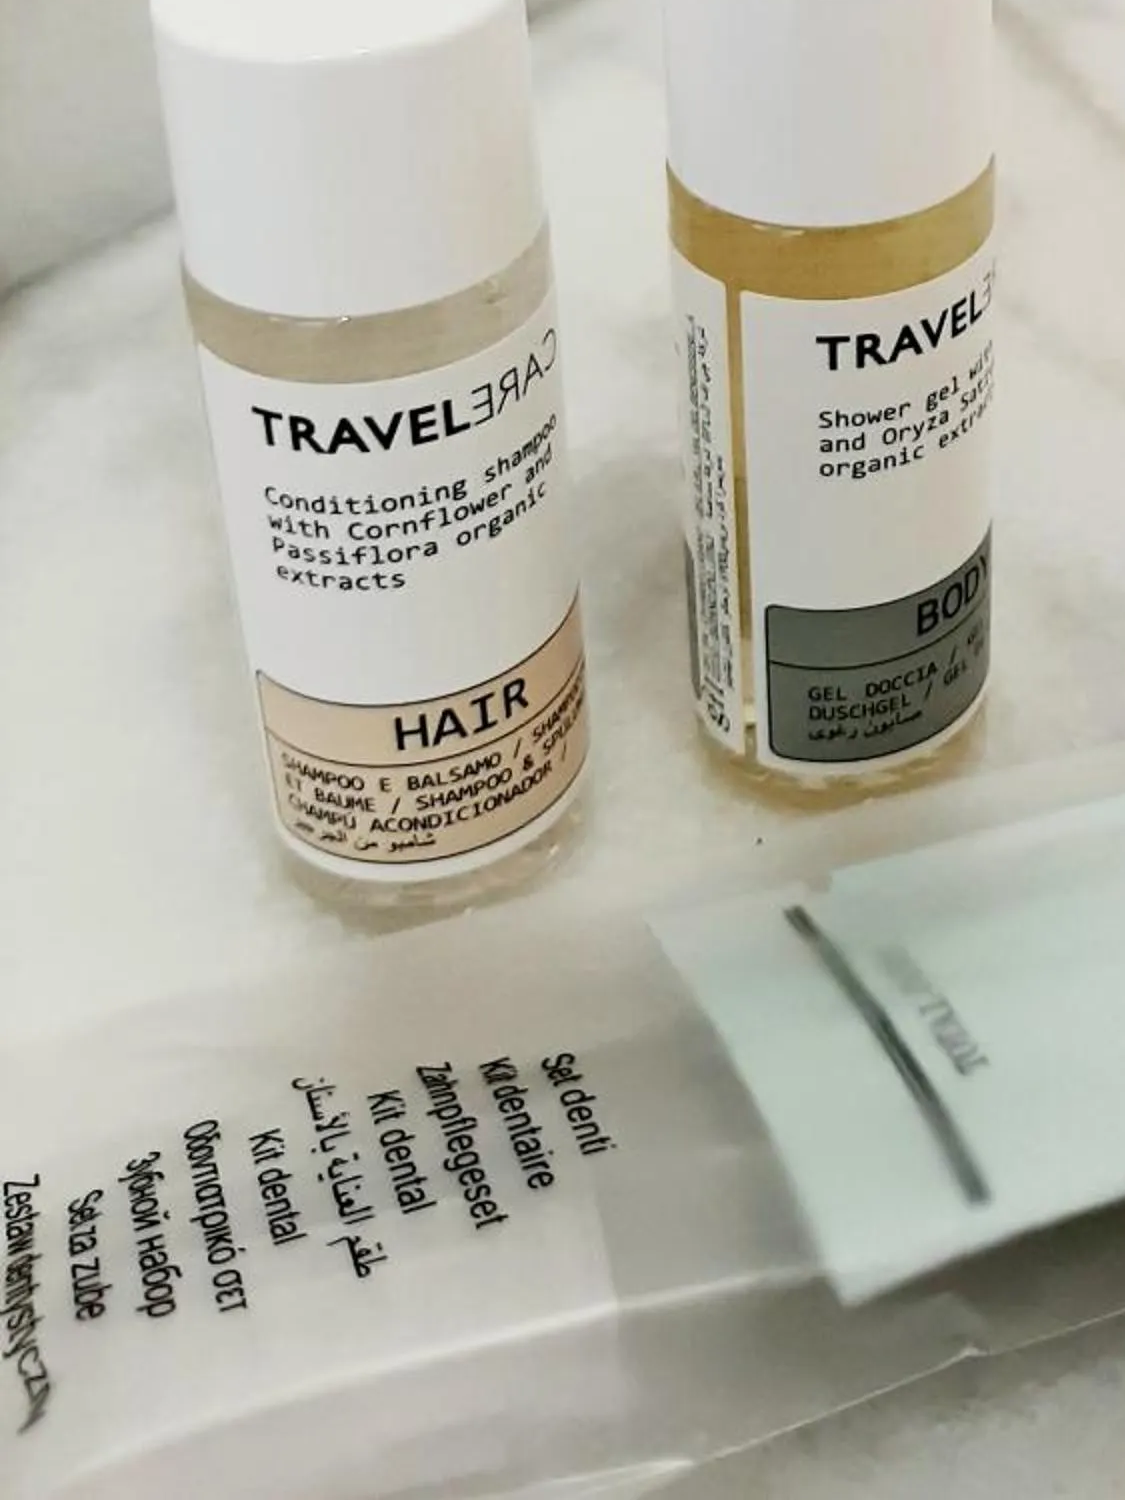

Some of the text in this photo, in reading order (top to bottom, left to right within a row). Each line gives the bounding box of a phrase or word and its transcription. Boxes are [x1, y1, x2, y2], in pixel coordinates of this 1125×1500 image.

[815, 290, 983, 371] TRAVEL
[251, 399, 472, 455] TRAVEL
[818, 401, 911, 430] Shower
[925, 376, 960, 413] gel
[818, 432, 867, 453] and
[881, 413, 950, 446] Oryza
[264, 413, 557, 516] Conditioning shampoo
[268, 442, 552, 542] with Cornflower and
[818, 445, 925, 480] organic
[272, 481, 548, 566] Passiflora organic
[276, 563, 406, 591] extracts
[393, 677, 530, 752] HAIR
[807, 685, 848, 702] GEL
[865, 661, 939, 699] DOCCIA
[808, 696, 911, 722] DUSCHGEL
[282, 752, 366, 792] SHAMPOO
[379, 776, 393, 793] E
[406, 751, 502, 792] BALSAMO
[314, 787, 376, 814] BAUME
[416, 767, 514, 811] SHAMPOO
[369, 760, 553, 833] ACONDICIONADOR
[492, 1086, 556, 1190] dentaire
[541, 1053, 617, 1157] Set denti
[367, 1089, 438, 1215] Kit dental
[415, 1061, 509, 1231] Zahnpflegeset
[3, 1173, 41, 1256] Zestaw
[248, 1128, 308, 1246] Kit dental
[136, 1233, 183, 1318] набор
